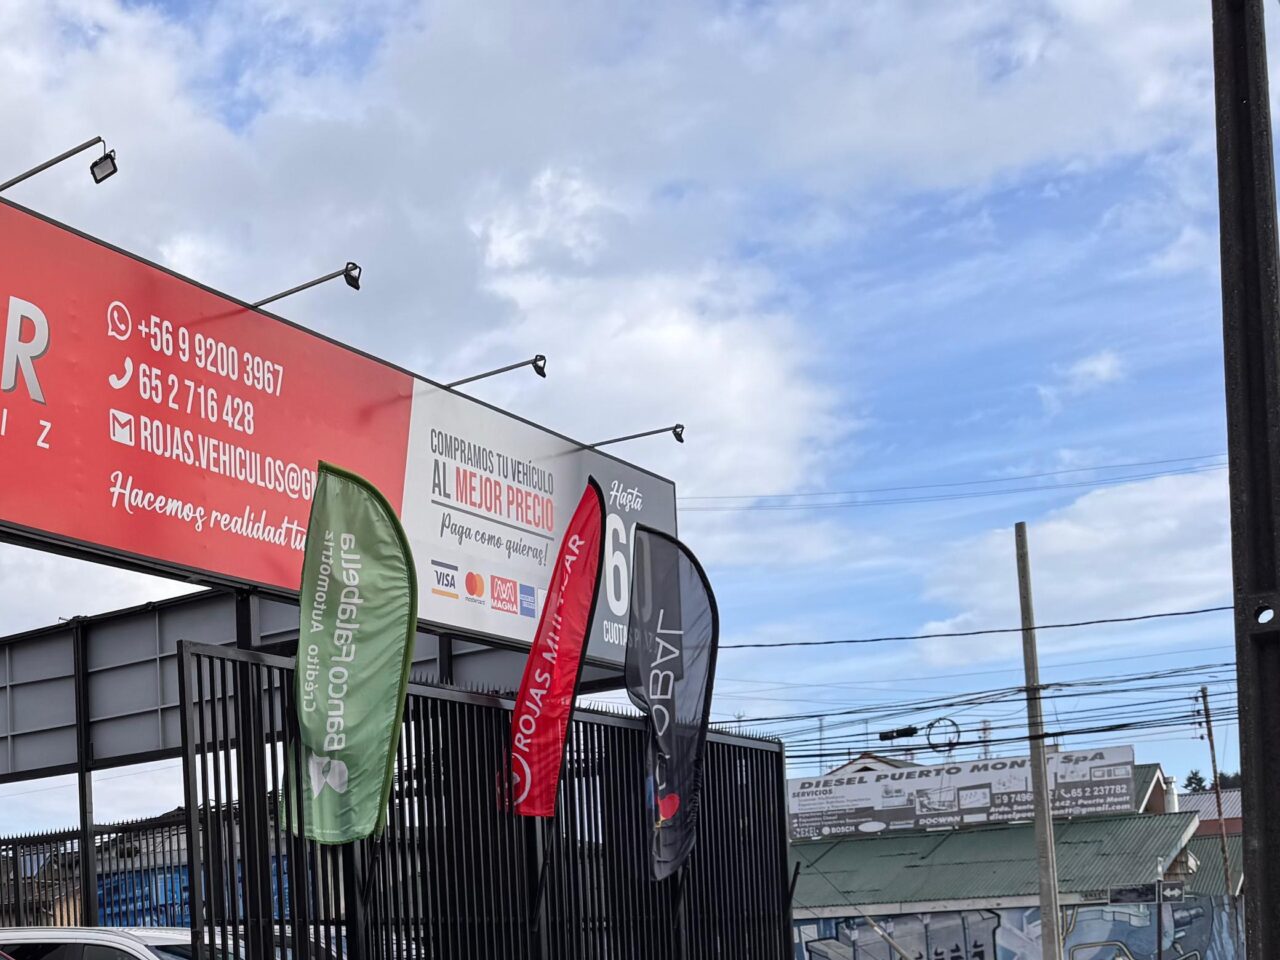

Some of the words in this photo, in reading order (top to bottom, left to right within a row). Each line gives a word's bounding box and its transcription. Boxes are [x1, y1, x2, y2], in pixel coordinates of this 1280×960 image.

[138, 313, 173, 356] +56
[178, 327, 190, 362] 9
[195, 333, 239, 381] 9200
[243, 351, 284, 397] 3967
[139, 363, 162, 404] 65
[168, 374, 179, 410] 2
[184, 379, 218, 423] 716
[222, 394, 255, 436] 428
[430, 428, 495, 475] COMPRAMOS
[496, 453, 509, 478] TU
[511, 458, 554, 496] VEHÍCULO
[110, 470, 207, 532] Hacemos
[210, 505, 287, 546] realidad
[431, 459, 451, 500] AL
[455, 466, 502, 516] MEJOR
[507, 484, 554, 532] PRECIO
[609, 480, 644, 512] Hasta
[440, 512, 473, 548] Paga
[474, 529, 503, 549] como
[505, 537, 549, 567] quieras!
[434, 570, 456, 589] VISA
[491, 599, 518, 613] MAGNA
[514, 668, 551, 752] ROJAS
[792, 788, 833, 799] SERVICIOS
[800, 776, 868, 790] DIESEL
[875, 766, 962, 783] PUERTO
[970, 755, 1054, 773] MONT
[1060, 752, 1106, 765] SpA
[1071, 788, 1082, 797] 65
[1085, 787, 1091, 796] 2
[1093, 784, 1127, 796] 237782
[831, 825, 855, 834] BOSCH
